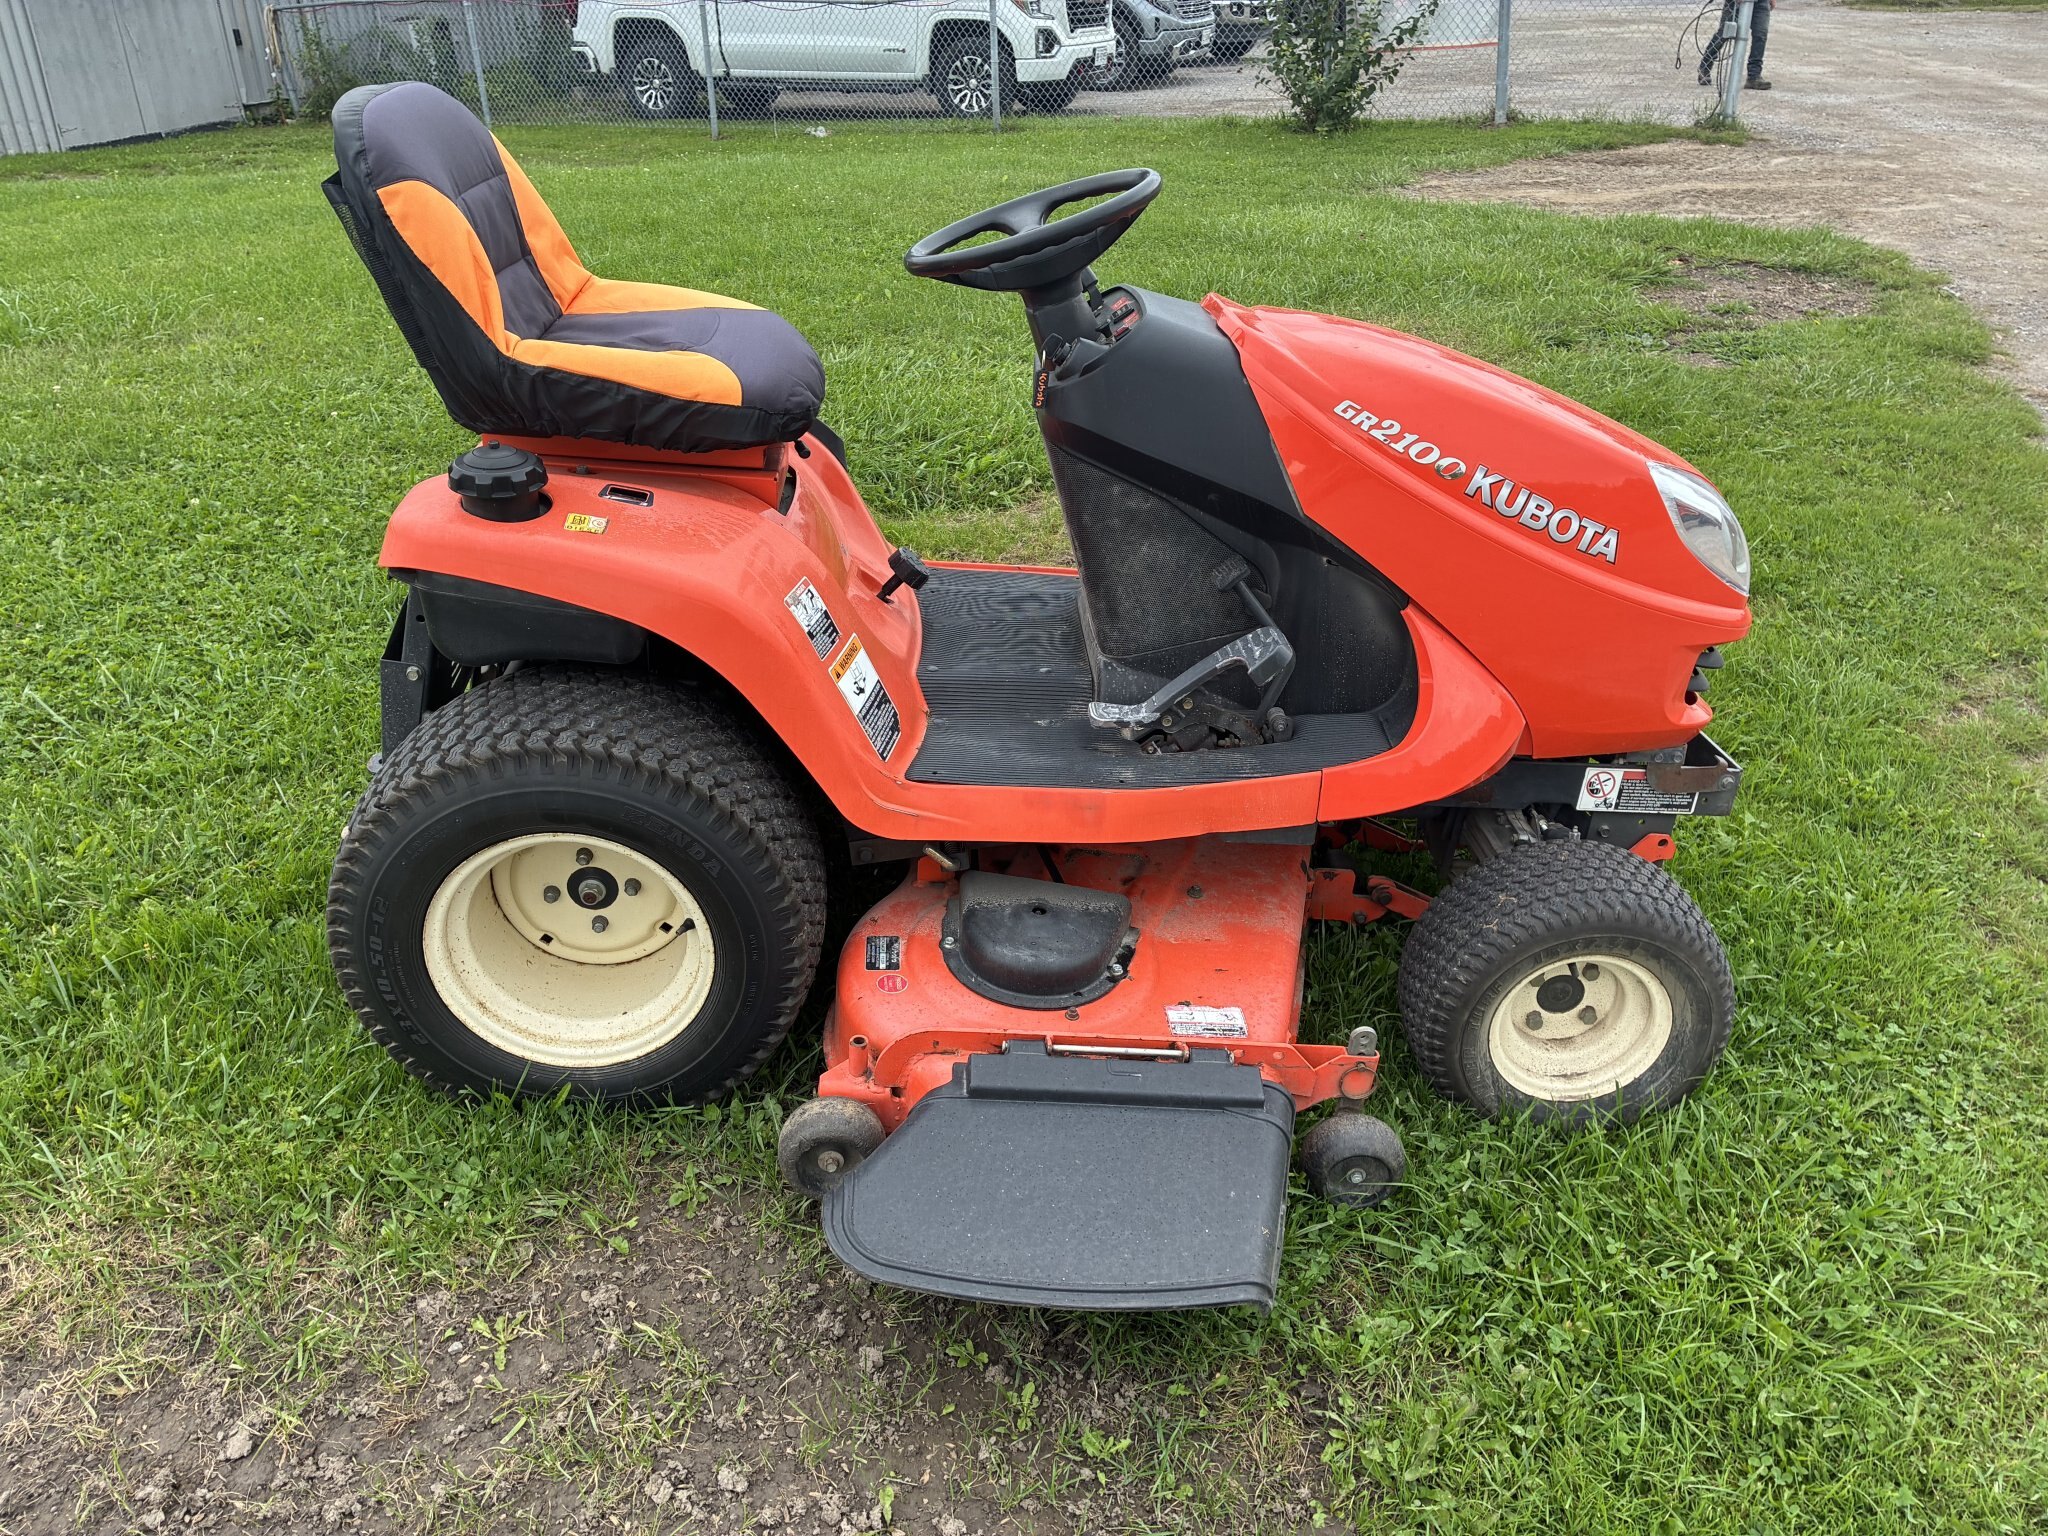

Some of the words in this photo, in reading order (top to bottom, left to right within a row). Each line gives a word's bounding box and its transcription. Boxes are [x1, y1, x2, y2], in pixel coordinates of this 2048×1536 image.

[1035, 372, 1048, 406] Kubota
[1464, 463, 1620, 565] KUBOTA
[838, 642, 859, 671] WARNING
[621, 804, 723, 879] KENDA
